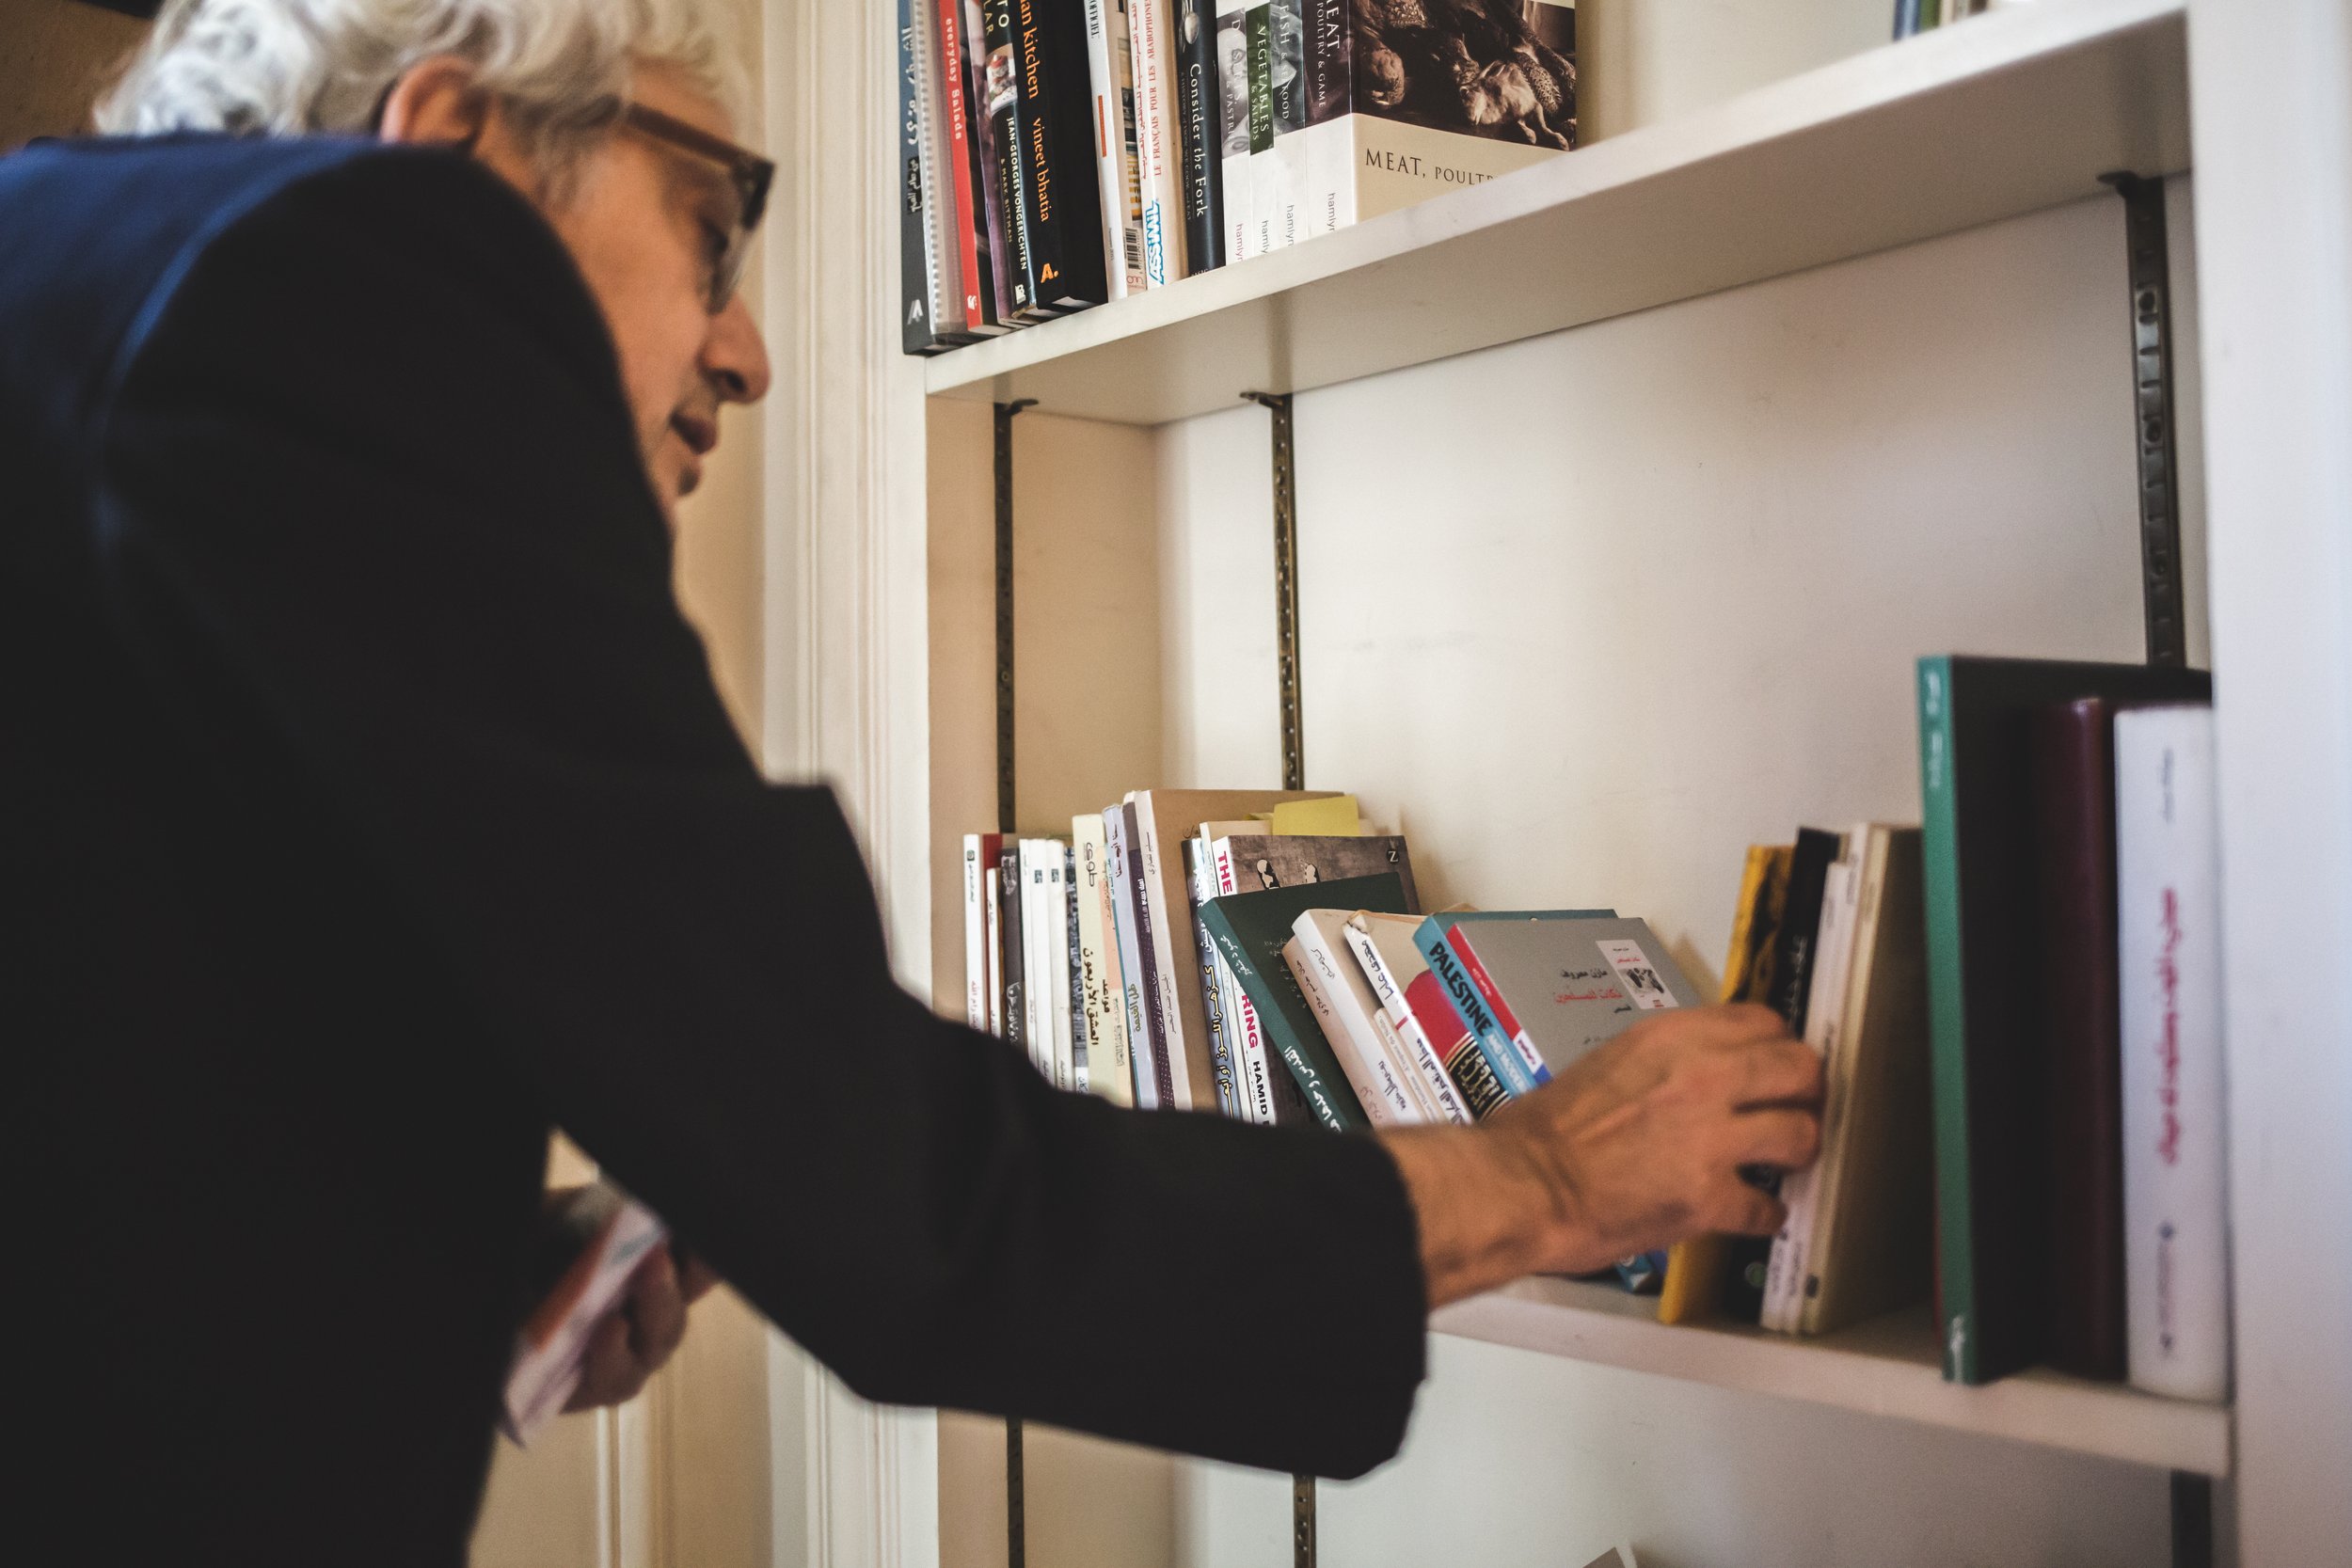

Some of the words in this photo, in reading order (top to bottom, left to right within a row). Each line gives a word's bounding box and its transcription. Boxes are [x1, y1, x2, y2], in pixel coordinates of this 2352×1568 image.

[1279, 5, 1290, 44] FISH
[1316, 2, 1326, 55] POULTRY
[946, 18, 958, 82] everyday
[952, 88, 962, 140] Salads
[1024, 26, 1041, 100] kitchen
[1147, 65, 1157, 83] LES
[1257, 25, 1269, 132] VEGETABLES
[1147, 87, 1158, 111] POUR
[1189, 62, 1204, 140] Consider
[1280, 65, 1289, 119] SEFOOD
[1318, 73, 1327, 108] GAME
[1032, 117, 1045, 168] vineet
[1150, 116, 1162, 160] FRANÇAIS
[1192, 148, 1208, 171] the
[1153, 165, 1162, 177] LE
[1365, 148, 1426, 179] MEAT,
[1435, 166, 1496, 186] POULT
[1006, 117, 1021, 190] JEAN-GEORGES
[1014, 192, 1027, 270] VONGERICHTEN
[1037, 167, 1053, 223] bhatia
[1195, 175, 1209, 219] Fork
[1004, 198, 1012, 244] BITTMAN
[1217, 850, 1233, 895] THE
[1388, 850, 1399, 863] Z
[1220, 934, 1239, 958] محمود
[1082, 947, 1100, 1006] الأربعون
[1429, 941, 1493, 1037] PALESTINE
[1087, 1007, 1100, 1046] العشق
[1129, 1001, 1143, 1033] الغيمة
[1241, 994, 1259, 1049] RING
[1252, 1060, 1268, 1116] HAMID
[1283, 1045, 1315, 1079] القدس
[1217, 1078, 1235, 1119] أبع
